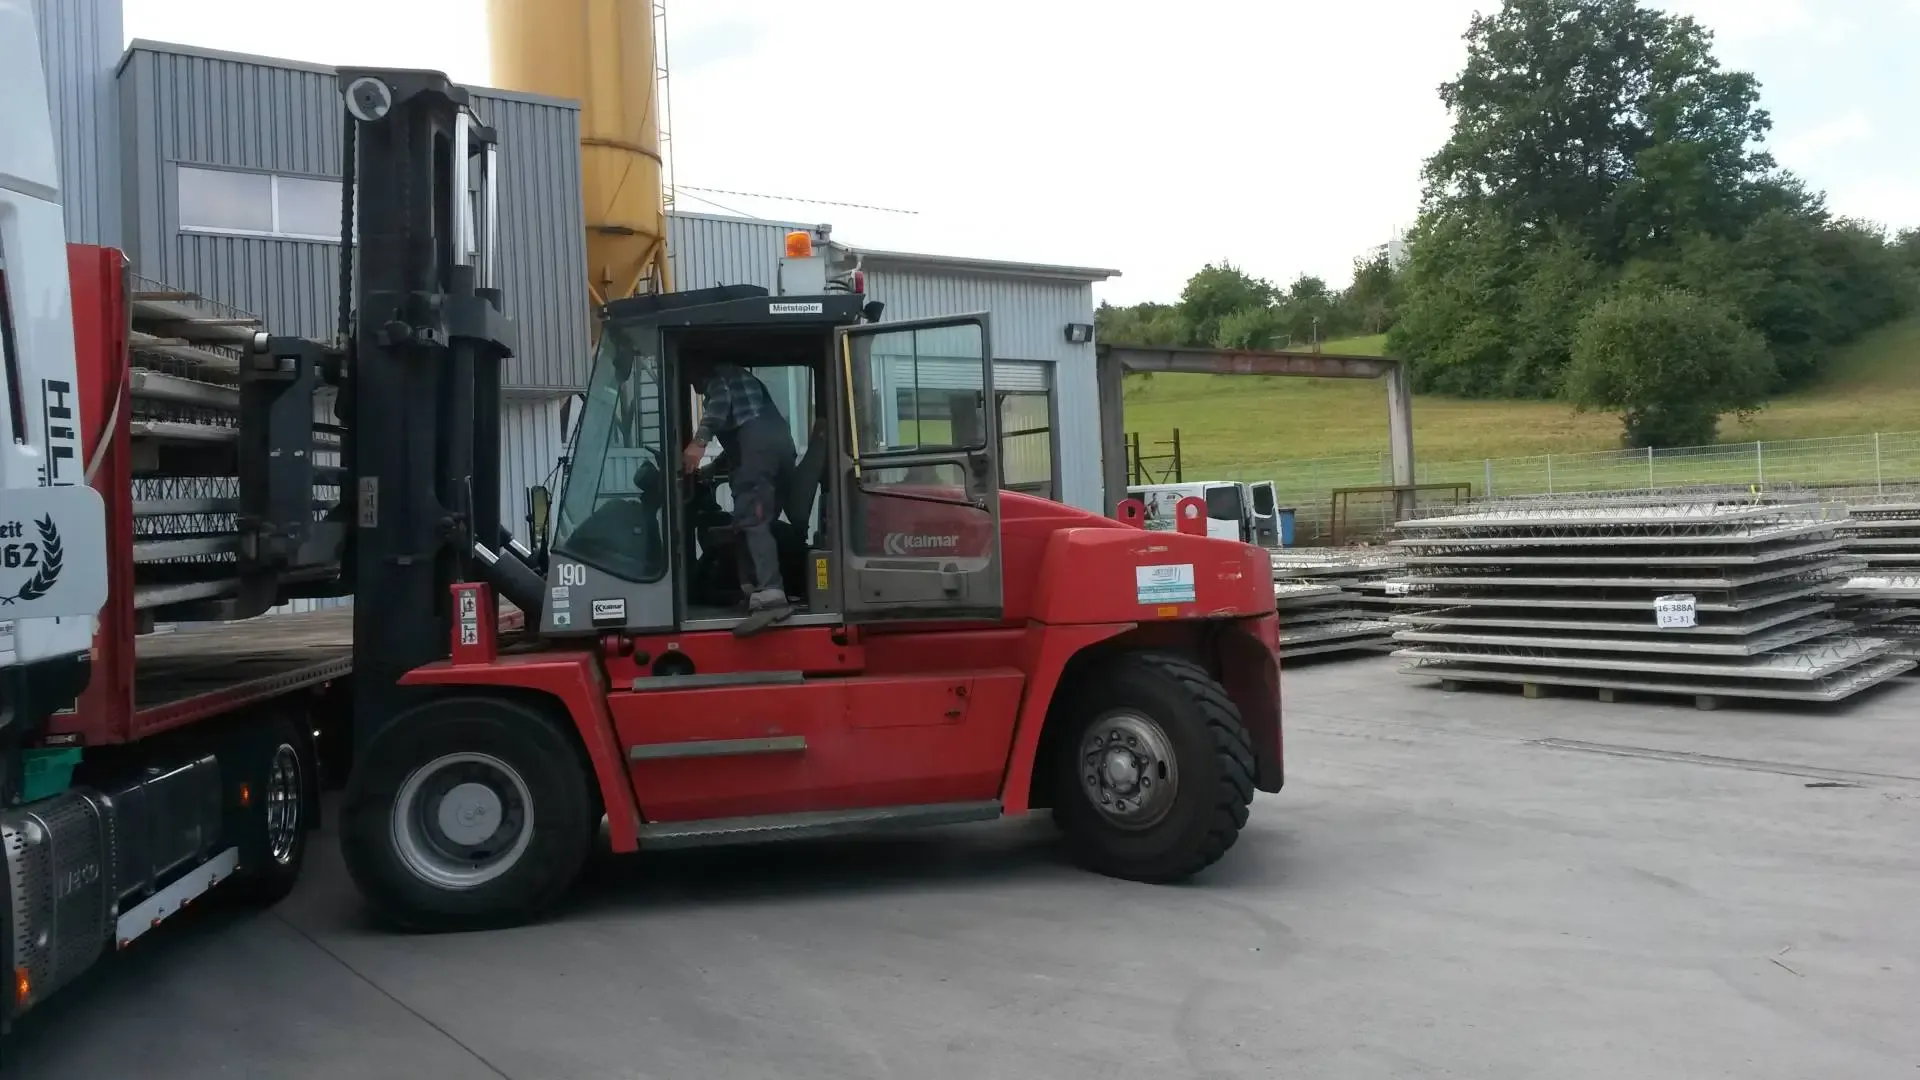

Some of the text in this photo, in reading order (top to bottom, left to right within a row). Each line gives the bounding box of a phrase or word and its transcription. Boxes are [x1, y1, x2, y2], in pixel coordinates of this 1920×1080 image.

[773, 304, 819, 313] Mietstapler
[0, 521, 23, 539] eit
[904, 534, 959, 549] Kalmar
[0, 543, 38, 568] 62
[557, 563, 586, 586] 190
[1658, 604, 1693, 612] 16-388A
